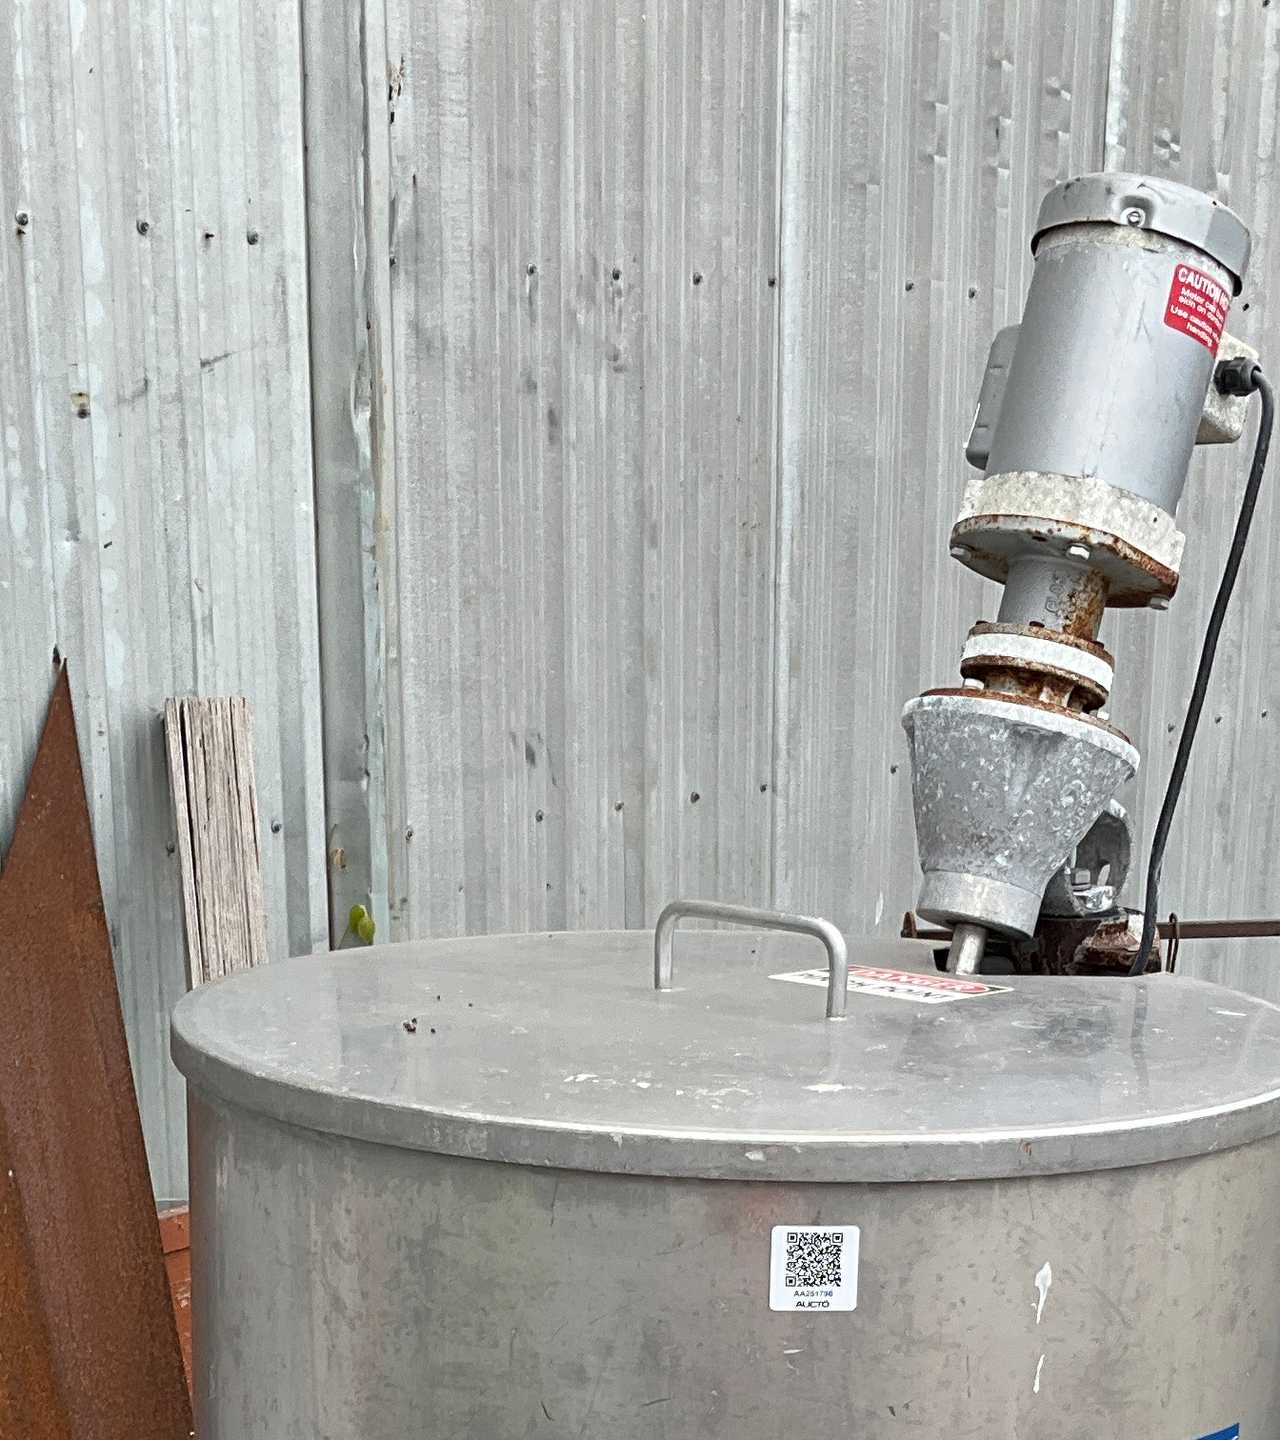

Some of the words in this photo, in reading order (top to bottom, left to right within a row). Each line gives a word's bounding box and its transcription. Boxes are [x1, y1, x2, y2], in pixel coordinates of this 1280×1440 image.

[1178, 267, 1221, 303] CAUTION
[1170, 304, 1189, 319] Use
[849, 968, 976, 993] DANGER
[878, 984, 956, 1001] POINT
